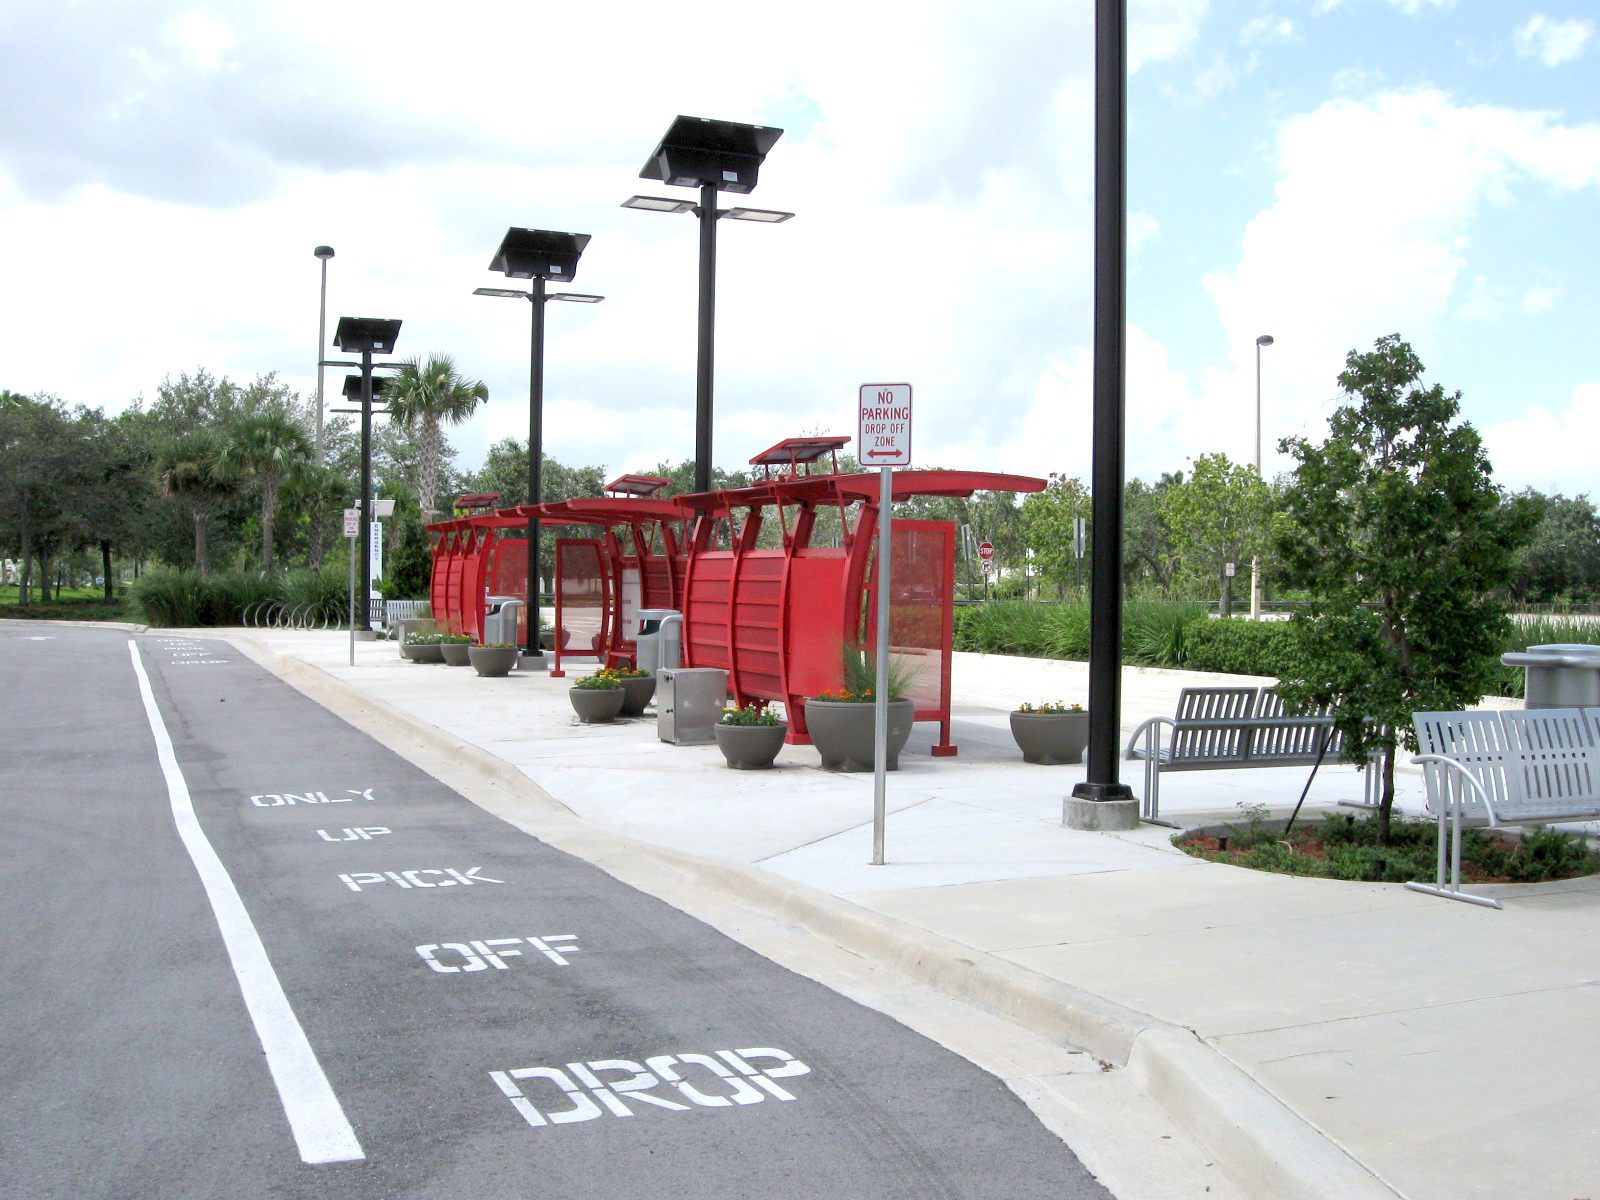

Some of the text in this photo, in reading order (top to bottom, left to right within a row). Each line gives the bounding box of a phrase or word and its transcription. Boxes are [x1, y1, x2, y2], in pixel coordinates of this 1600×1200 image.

[878, 391, 894, 405] NO
[862, 407, 909, 421] PARKING
[865, 423, 905, 434] DROP OFF
[874, 436, 896, 447] ZONE
[980, 547, 993, 555] STOP
[250, 788, 375, 808] ONLY
[316, 826, 392, 842] UP
[338, 866, 505, 892] PICK
[415, 934, 580, 973] OFF
[488, 1047, 812, 1127] DROP
